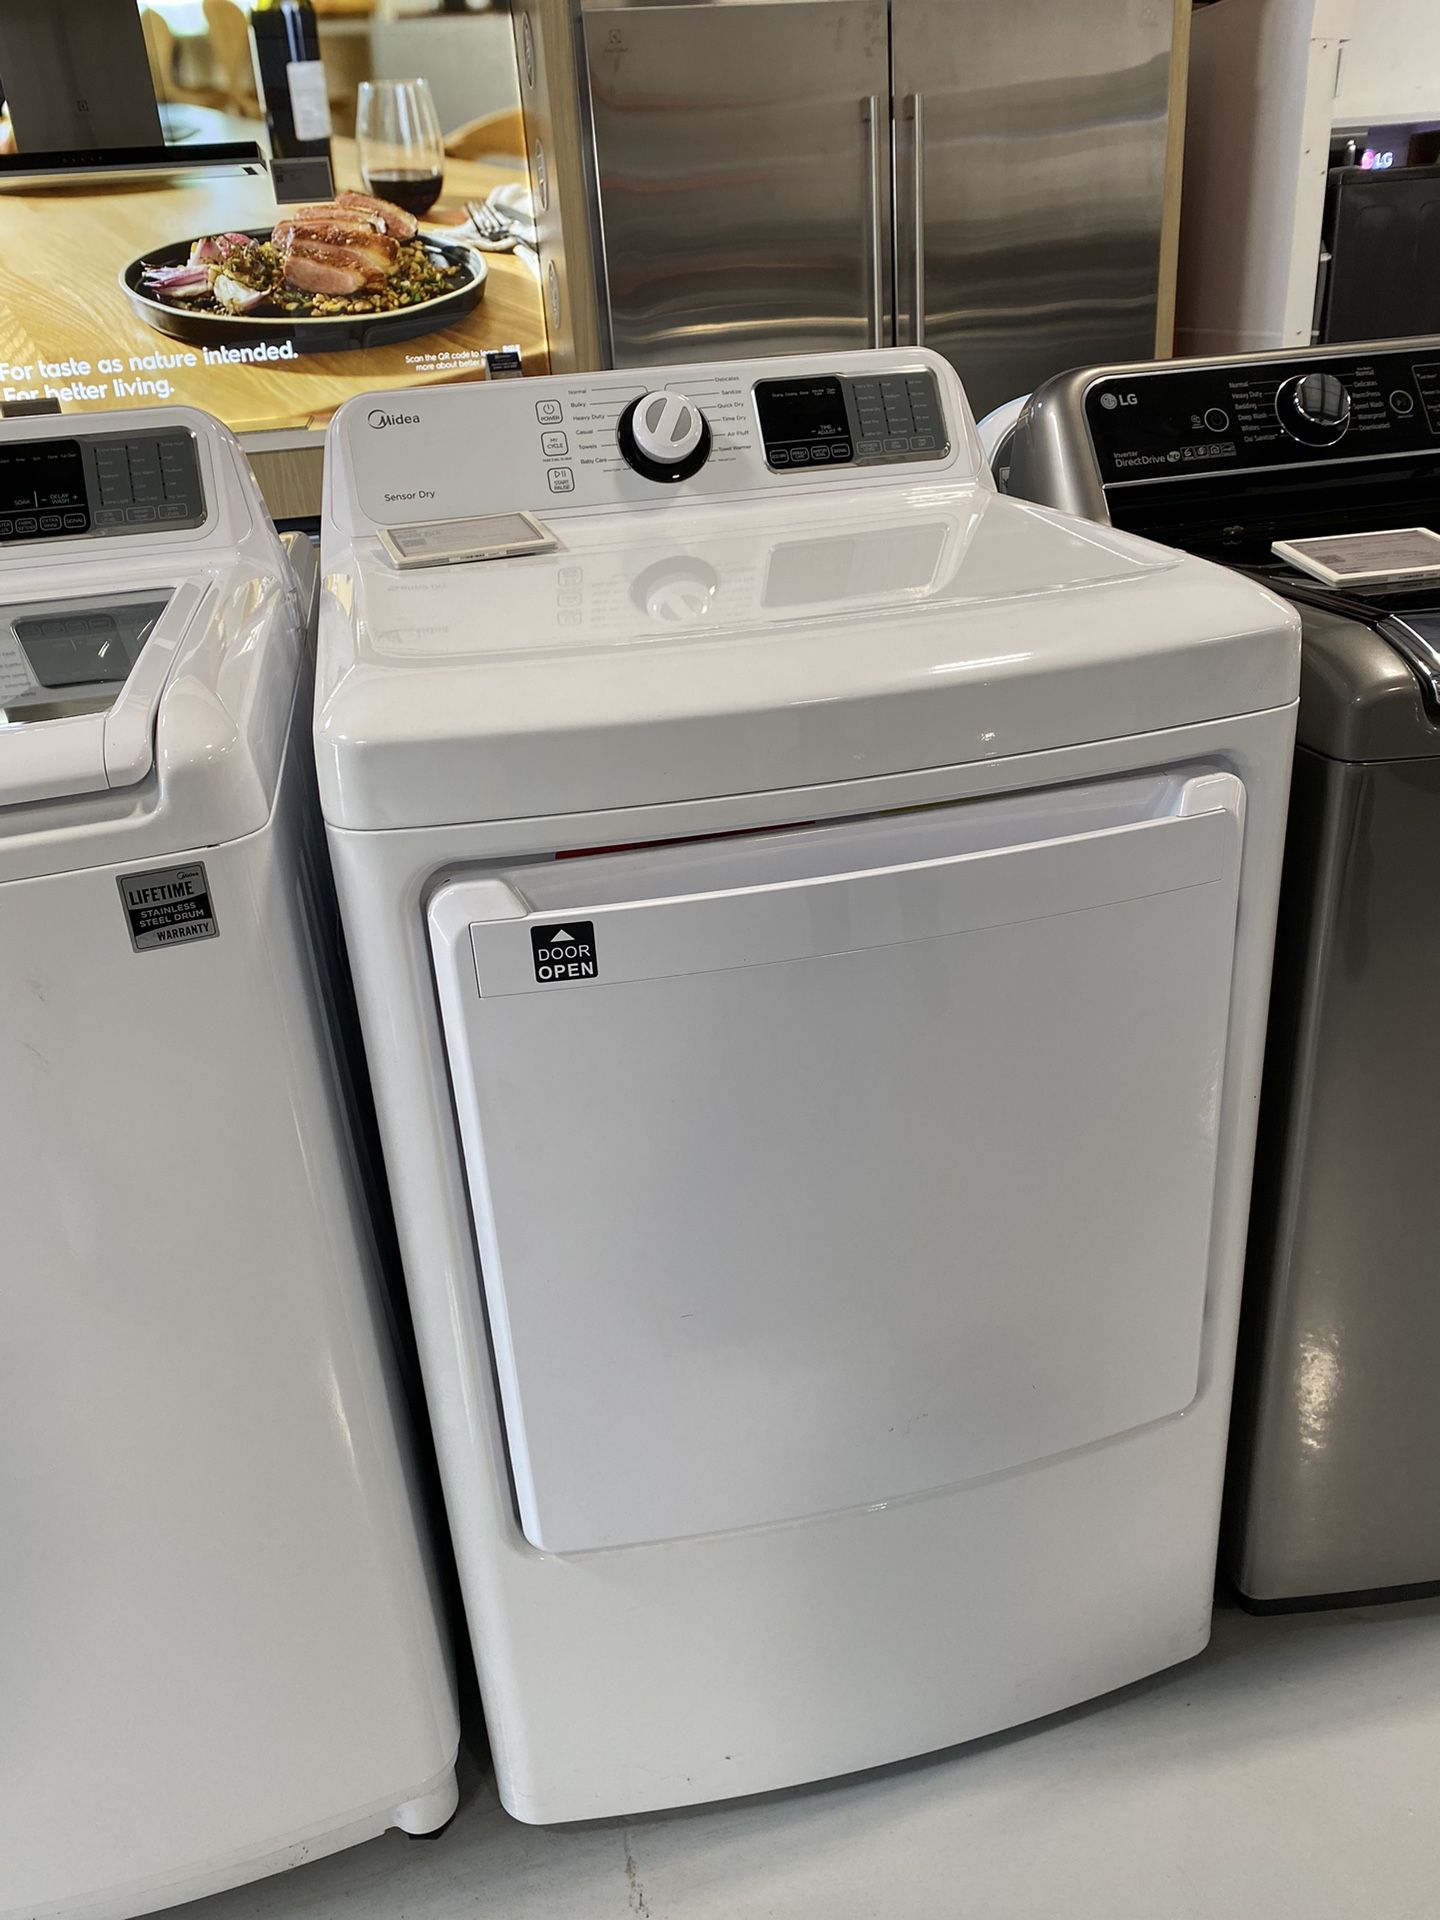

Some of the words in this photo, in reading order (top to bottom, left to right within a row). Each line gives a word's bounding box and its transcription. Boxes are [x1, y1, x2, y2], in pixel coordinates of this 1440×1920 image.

[1372, 151, 1393, 169] LG
[0, 363, 33, 382] For
[37, 357, 91, 378] taste
[98, 358, 123, 374] as
[129, 351, 197, 372] nature
[203, 340, 299, 365] intended.
[405, 354, 424, 364] Scan
[425, 353, 437, 361] the
[438, 352, 450, 361] QR
[451, 350, 470, 360] code
[471, 350, 479, 358] to
[416, 363, 435, 371] more
[436, 361, 458, 369] about
[458, 359, 480, 368] better
[3, 387, 39, 401] For
[44, 382, 108, 401] better
[113, 377, 175, 399] living.
[1119, 393, 1138, 406] LG
[368, 409, 420, 429] Midea
[384, 492, 416, 502] Sensor
[418, 490, 436, 499] Dry
[129, 881, 194, 906] LIFETIME
[139, 916, 172, 928] STEEL
[173, 909, 205, 921] DRUM
[140, 902, 197, 918] STAINLESS
[156, 922, 210, 941] WARRANTY
[538, 944, 591, 961] DOOR
[538, 961, 594, 980] OPEN
